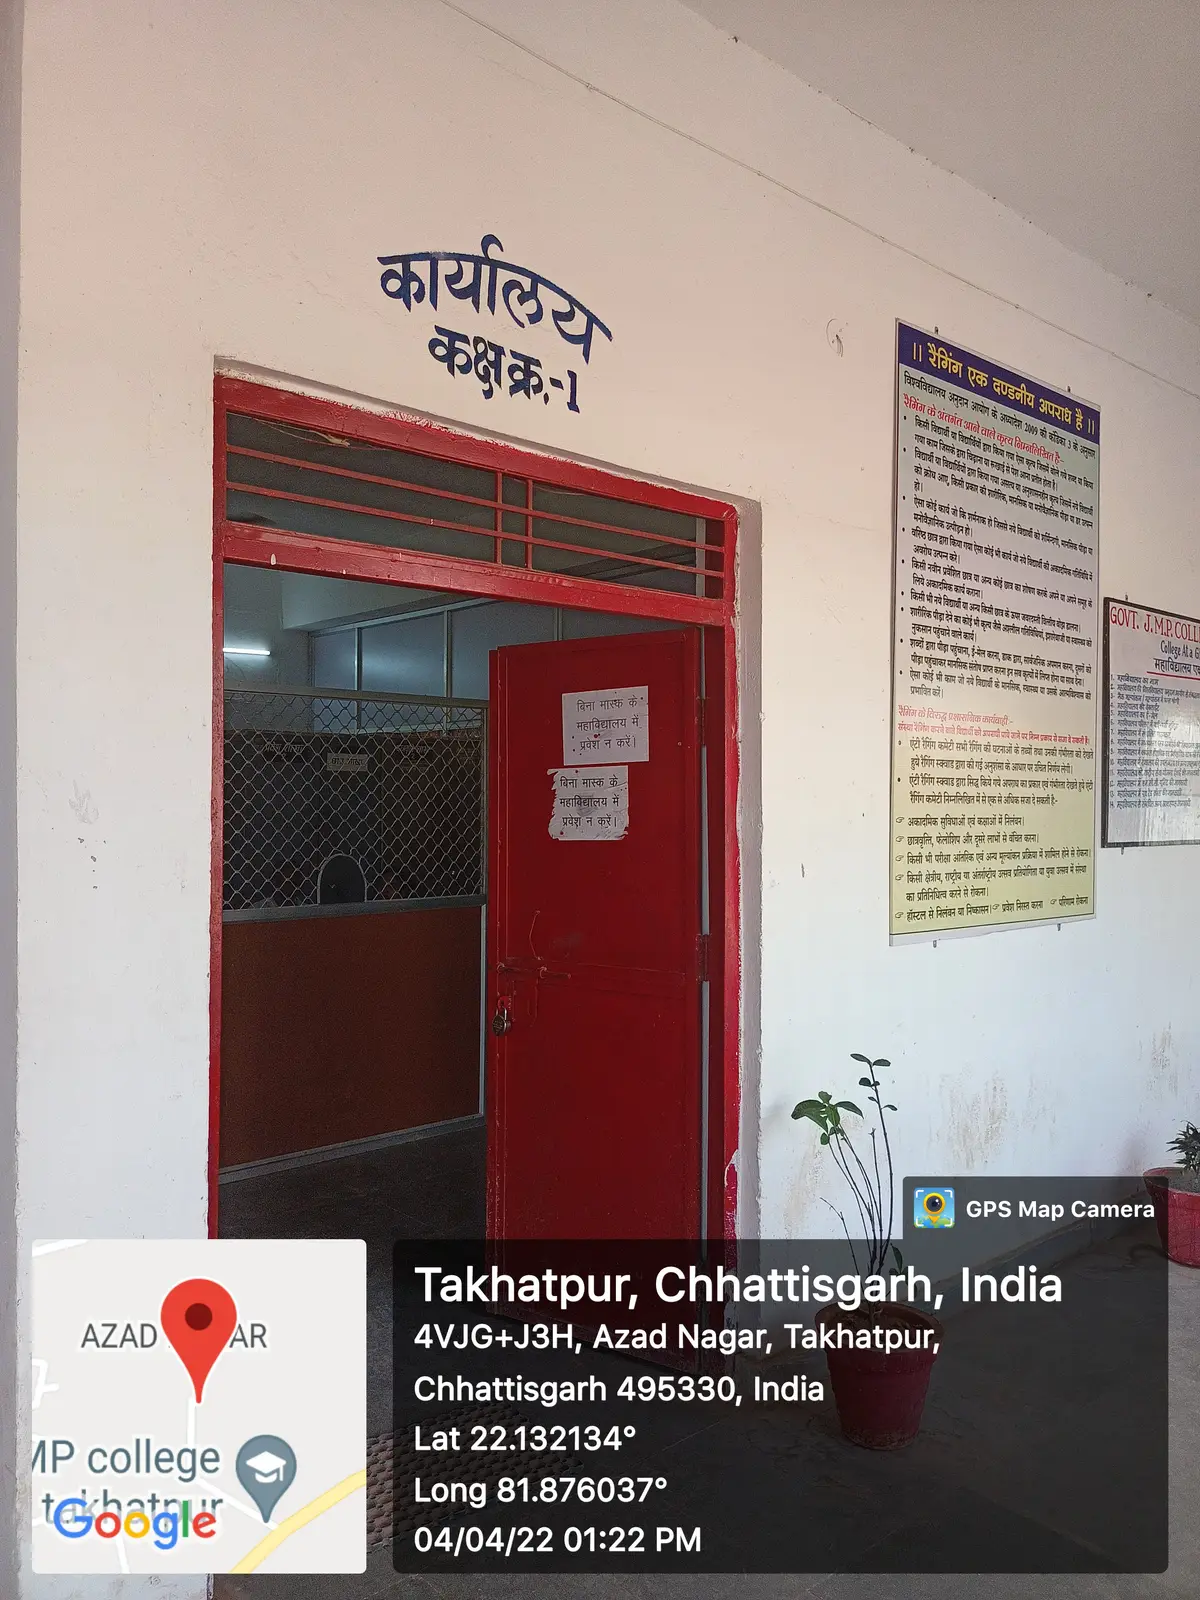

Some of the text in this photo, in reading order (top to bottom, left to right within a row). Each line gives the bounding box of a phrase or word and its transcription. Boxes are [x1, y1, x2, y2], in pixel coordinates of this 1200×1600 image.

[377, 234, 613, 365] कार्यालय
[927, 343, 963, 377] रैगिंग
[967, 367, 988, 387] एक
[993, 377, 1035, 408] दण्डनीय
[1039, 398, 1072, 425] अपराध
[1110, 606, 1139, 629] GOVT.
[1161, 640, 1180, 659] College
[1153, 657, 1191, 673] महाविद्यालय
[577, 695, 638, 712] बिना मास्क के
[576, 718, 626, 731] महाविद्यालय
[580, 737, 599, 750] प्रवेश
[604, 740, 611, 748] न
[560, 774, 618, 788] बिना मास्क के
[560, 795, 607, 807] महाविद्यालय
[562, 814, 581, 827] प्रवेश
[586, 817, 592, 826] न
[907, 813, 938, 826] अकादमिक
[940, 813, 965, 830] सुविधाओं
[967, 814, 976, 828] एवं
[977, 813, 996, 827] कक्षाओं
[935, 831, 961, 845] फेलोशिप
[962, 831, 973, 844] और
[974, 831, 985, 848] दूसरे
[986, 831, 1001, 843] लाभों
[1002, 831, 1007, 843] से
[905, 884, 988, 902] का प्रतिनिधित्व करने से रोकना।
